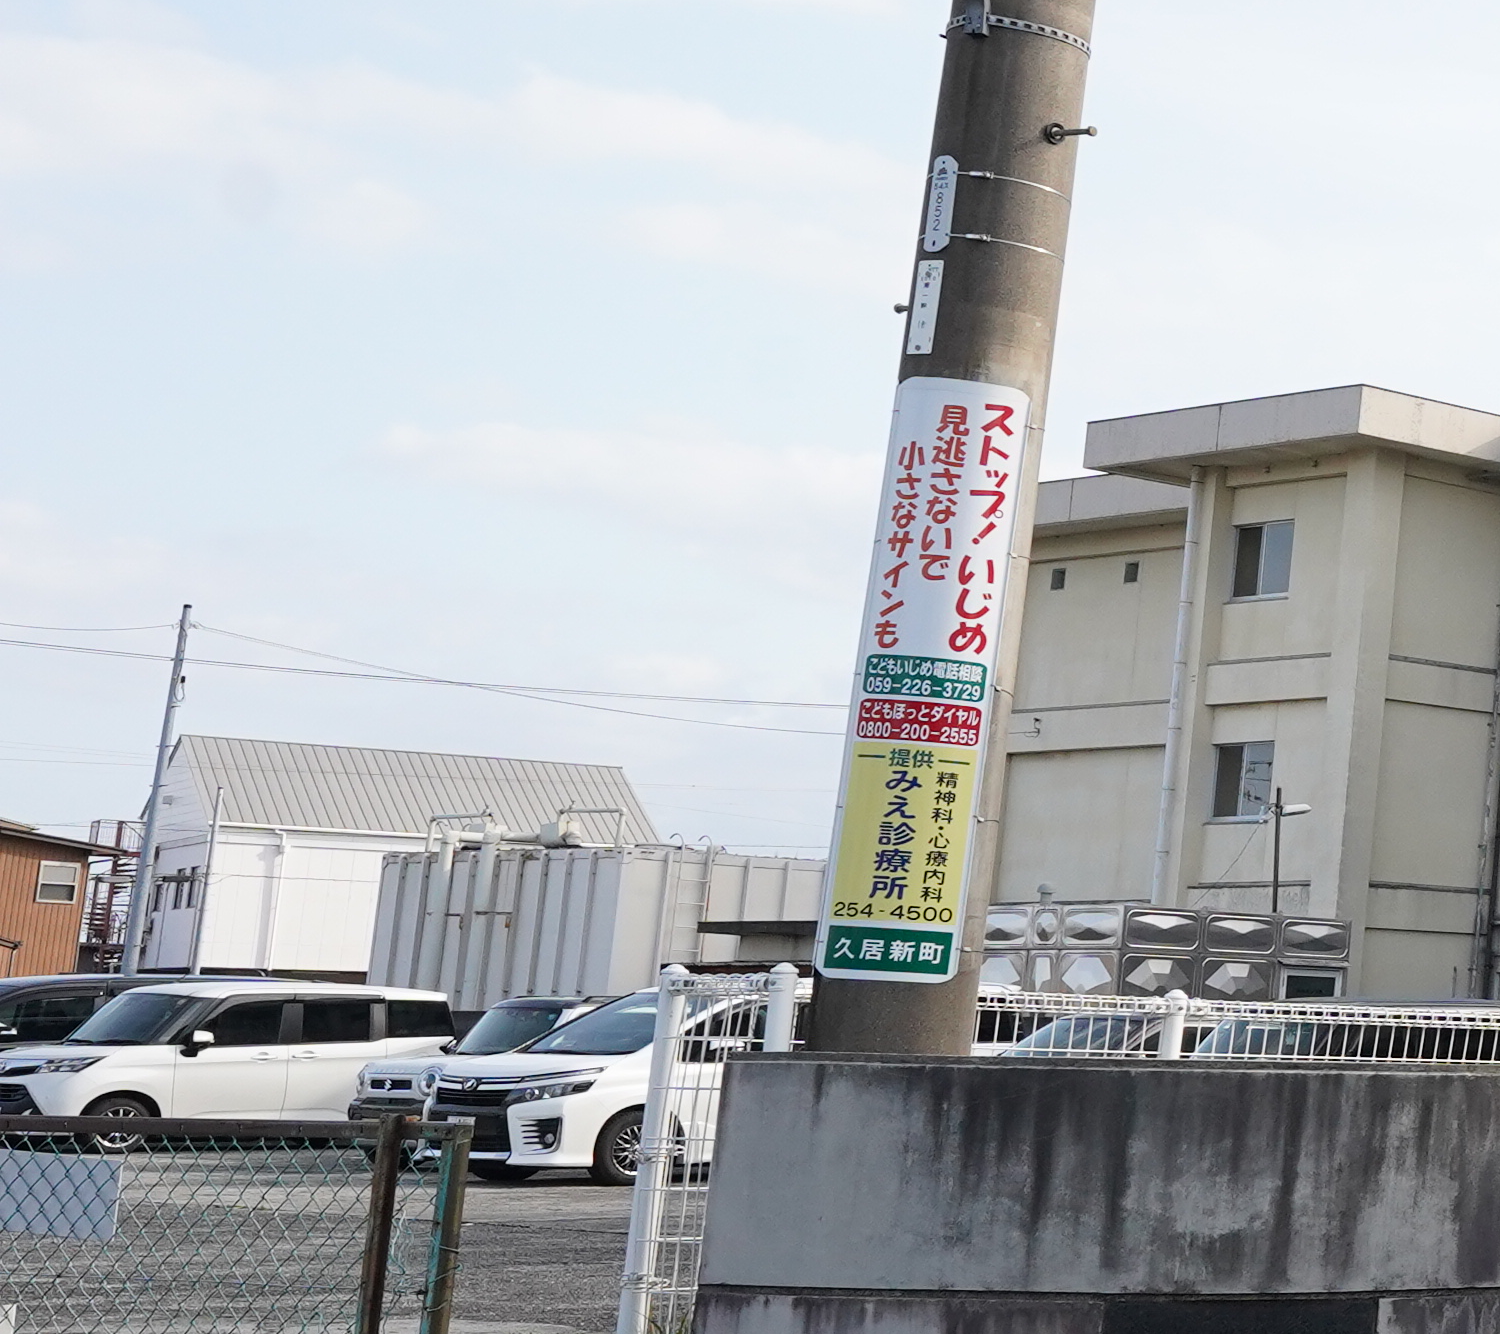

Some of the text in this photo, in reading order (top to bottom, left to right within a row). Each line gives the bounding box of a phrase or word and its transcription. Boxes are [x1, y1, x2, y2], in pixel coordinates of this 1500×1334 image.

[919, 404, 970, 581] 見逃さないで
[874, 441, 926, 649] 小さなサインも
[868, 657, 983, 684] こどもいじめ電話相談
[866, 676, 981, 701] 059-226-3729
[861, 700, 979, 726] こどもほっとダイヤル
[858, 723, 977, 746] 0800-200-2555
[888, 748, 935, 769] 提供
[869, 770, 923, 900] みえ診療所
[920, 771, 959, 903] 精神科・心療内科
[833, 901, 953, 923] 254-4500
[833, 936, 945, 965] 久居新町
